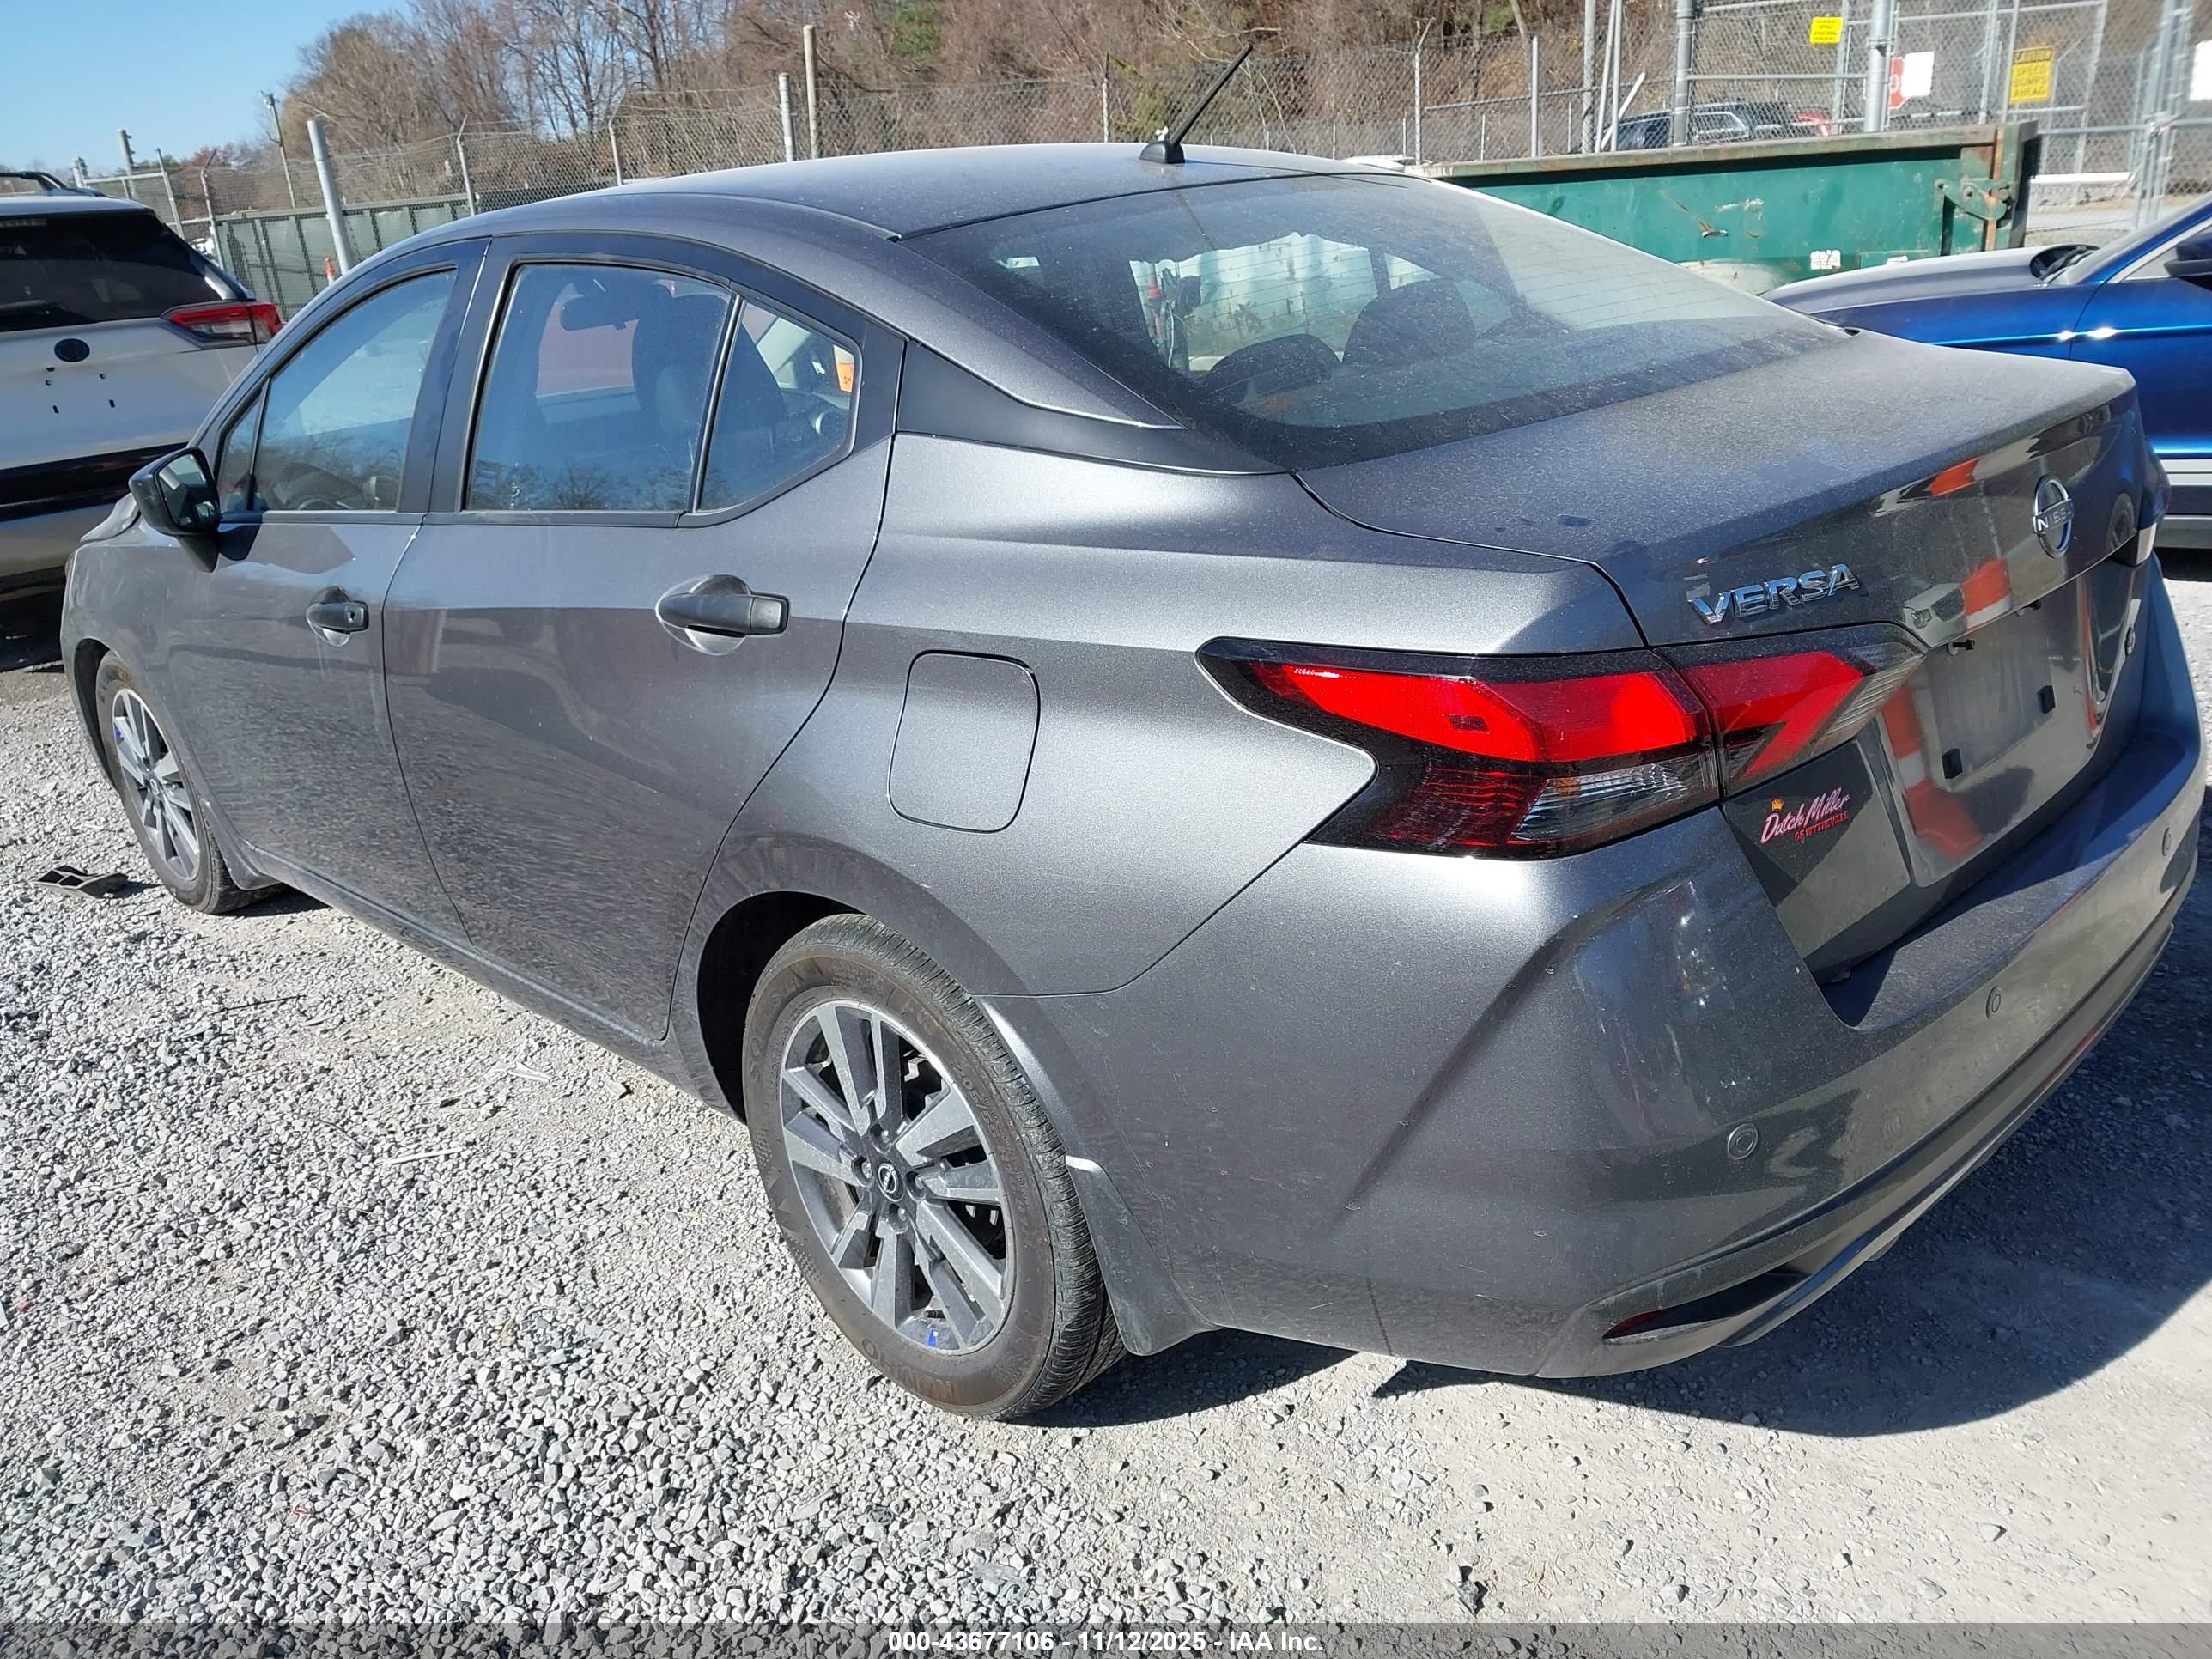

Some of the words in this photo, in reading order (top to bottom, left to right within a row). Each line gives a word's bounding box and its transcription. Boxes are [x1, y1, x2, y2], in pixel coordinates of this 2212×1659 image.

[1687, 563, 1860, 625] VERSA
[1760, 802, 1805, 843] Dutch
[1803, 787, 1850, 828] Miller
